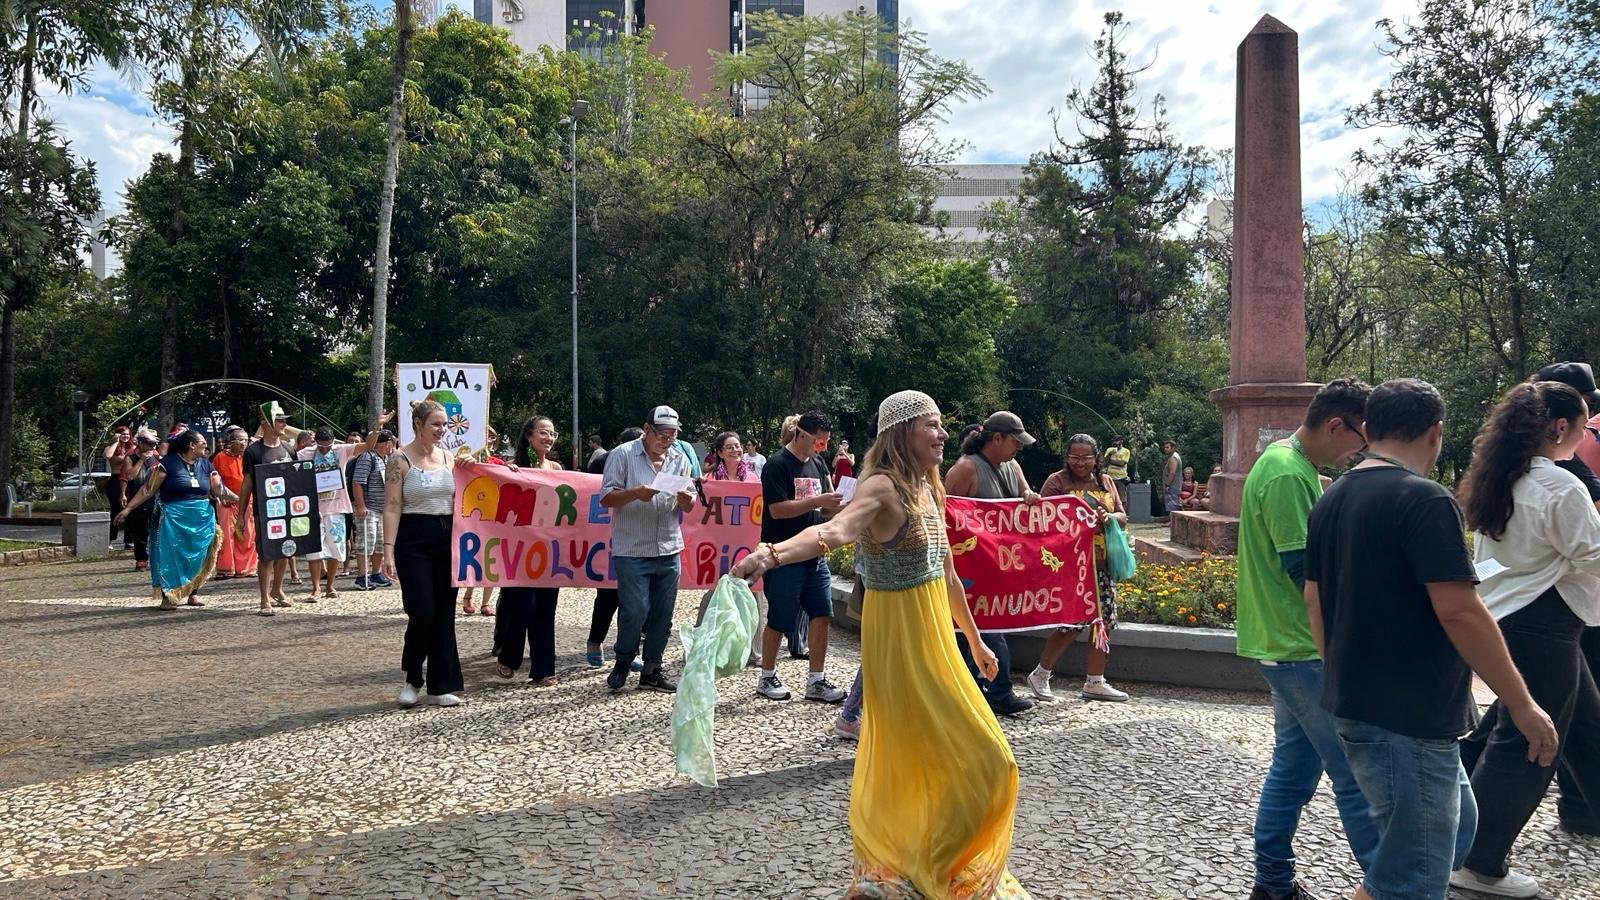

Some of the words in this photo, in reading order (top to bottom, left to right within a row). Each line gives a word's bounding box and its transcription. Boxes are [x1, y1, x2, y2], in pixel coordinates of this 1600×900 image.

[421, 368, 469, 390] UAA
[461, 475, 578, 527] AMAR
[997, 543, 1026, 571] DE
[965, 586, 1064, 617] ANUDOS
